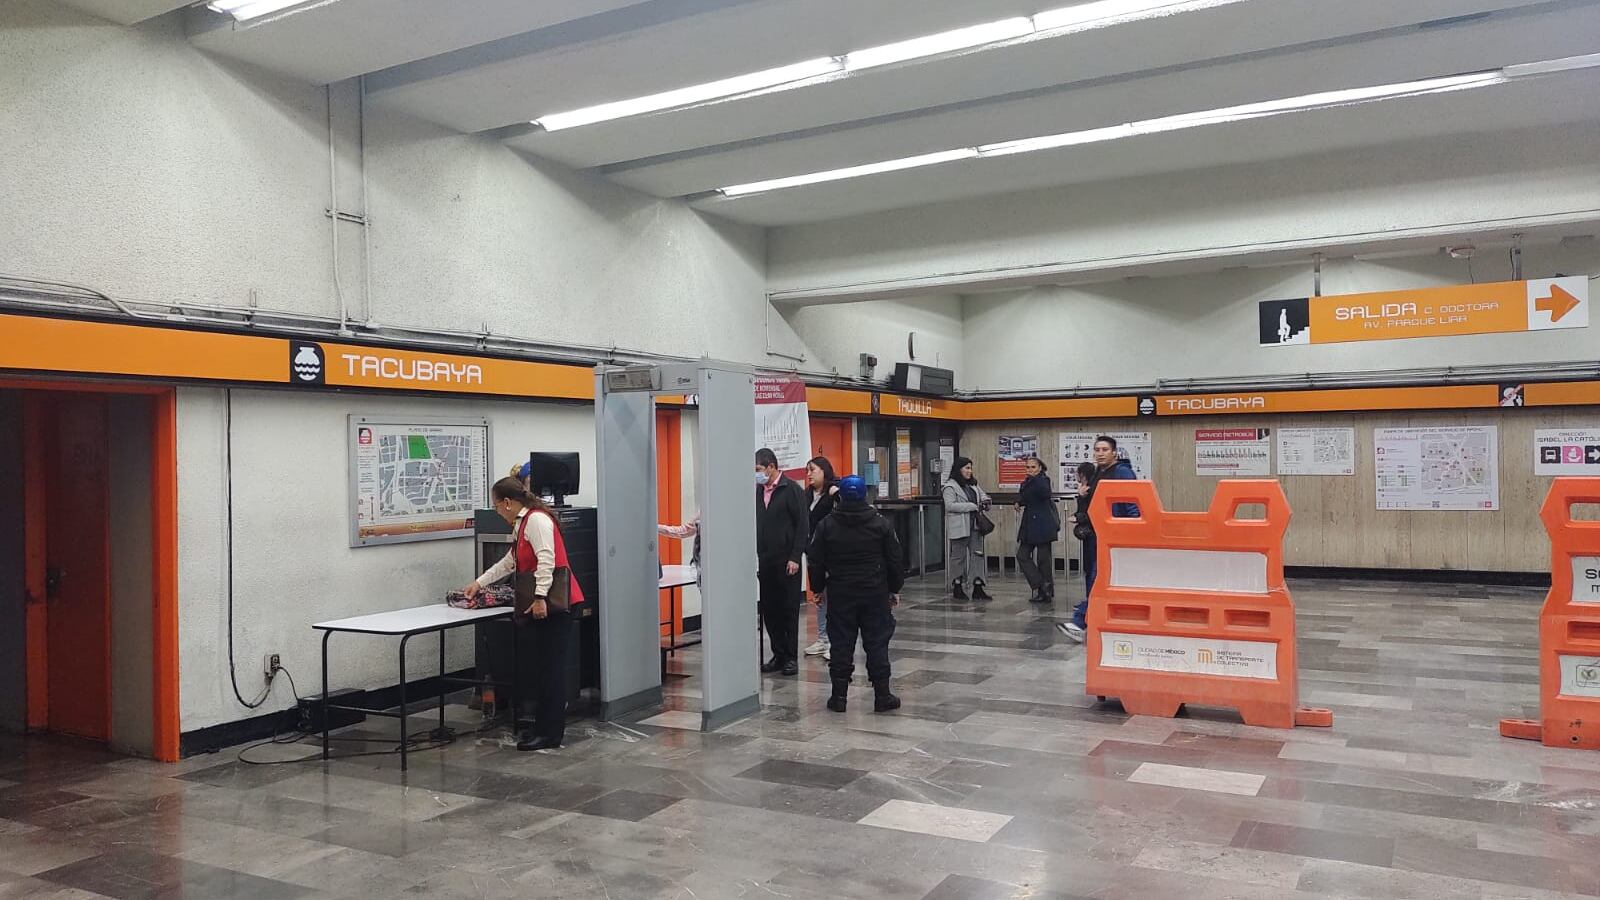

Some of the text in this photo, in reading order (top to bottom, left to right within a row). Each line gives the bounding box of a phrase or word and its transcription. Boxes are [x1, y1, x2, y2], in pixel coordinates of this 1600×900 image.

[1335, 302, 1499, 320] SALIDA C DOCTORA
[1364, 315, 1468, 329] AV. PARQUE LIRA
[341, 353, 482, 384] TACUBAYA
[897, 398, 932, 415] TAQUILLA
[1166, 396, 1265, 410] TACUBAYA
